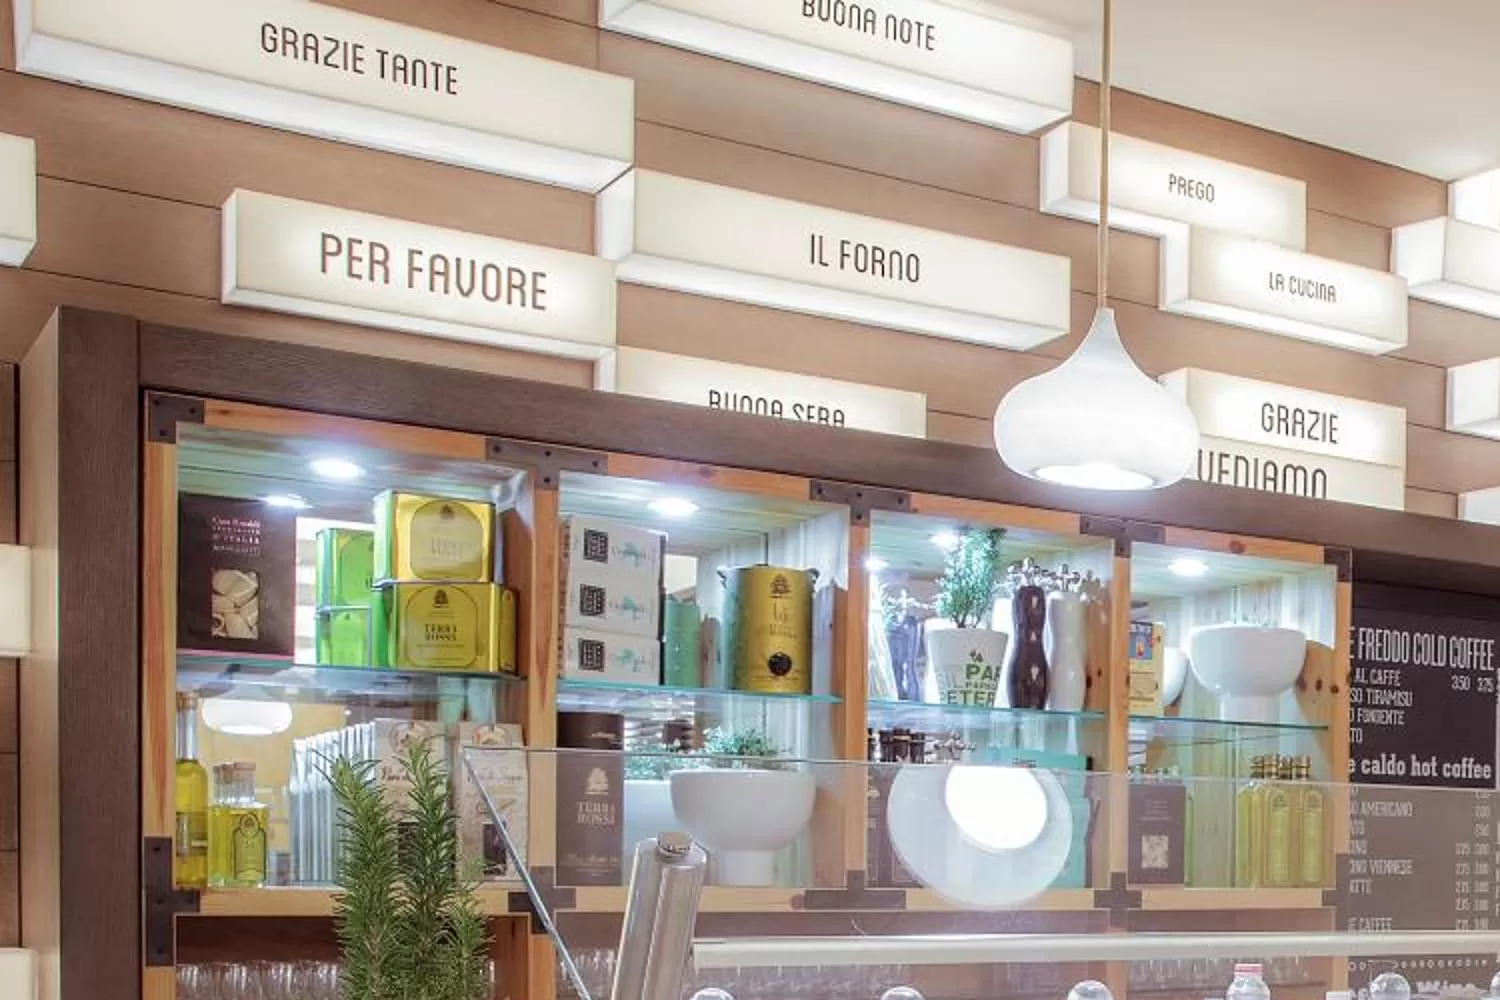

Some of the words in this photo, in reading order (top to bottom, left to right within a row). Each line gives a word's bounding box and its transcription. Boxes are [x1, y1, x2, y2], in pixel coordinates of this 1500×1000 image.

[885, 13, 935, 51] NOTE
[260, 22, 366, 74] GRAZIE
[376, 47, 458, 95] TANTE
[1168, 173, 1215, 203] PREGO
[319, 231, 390, 285] PER
[407, 249, 547, 311] FAVORE
[810, 233, 829, 267] IL
[839, 239, 920, 283] FORNO
[1268, 271, 1285, 292] LA
[1289, 275, 1337, 304] CUCINA
[1261, 402, 1338, 444] GRAZIE
[1358, 626, 1409, 665] FREDDO
[1413, 632, 1446, 668] COLD
[1449, 636, 1495, 671] COFFEE
[1357, 707, 1405, 725] FONDENTE
[1361, 752, 1405, 775] caldo
[1410, 753, 1438, 777] hot
[1442, 756, 1492, 780] coffee
[1360, 801, 1413, 817] AMERICANO
